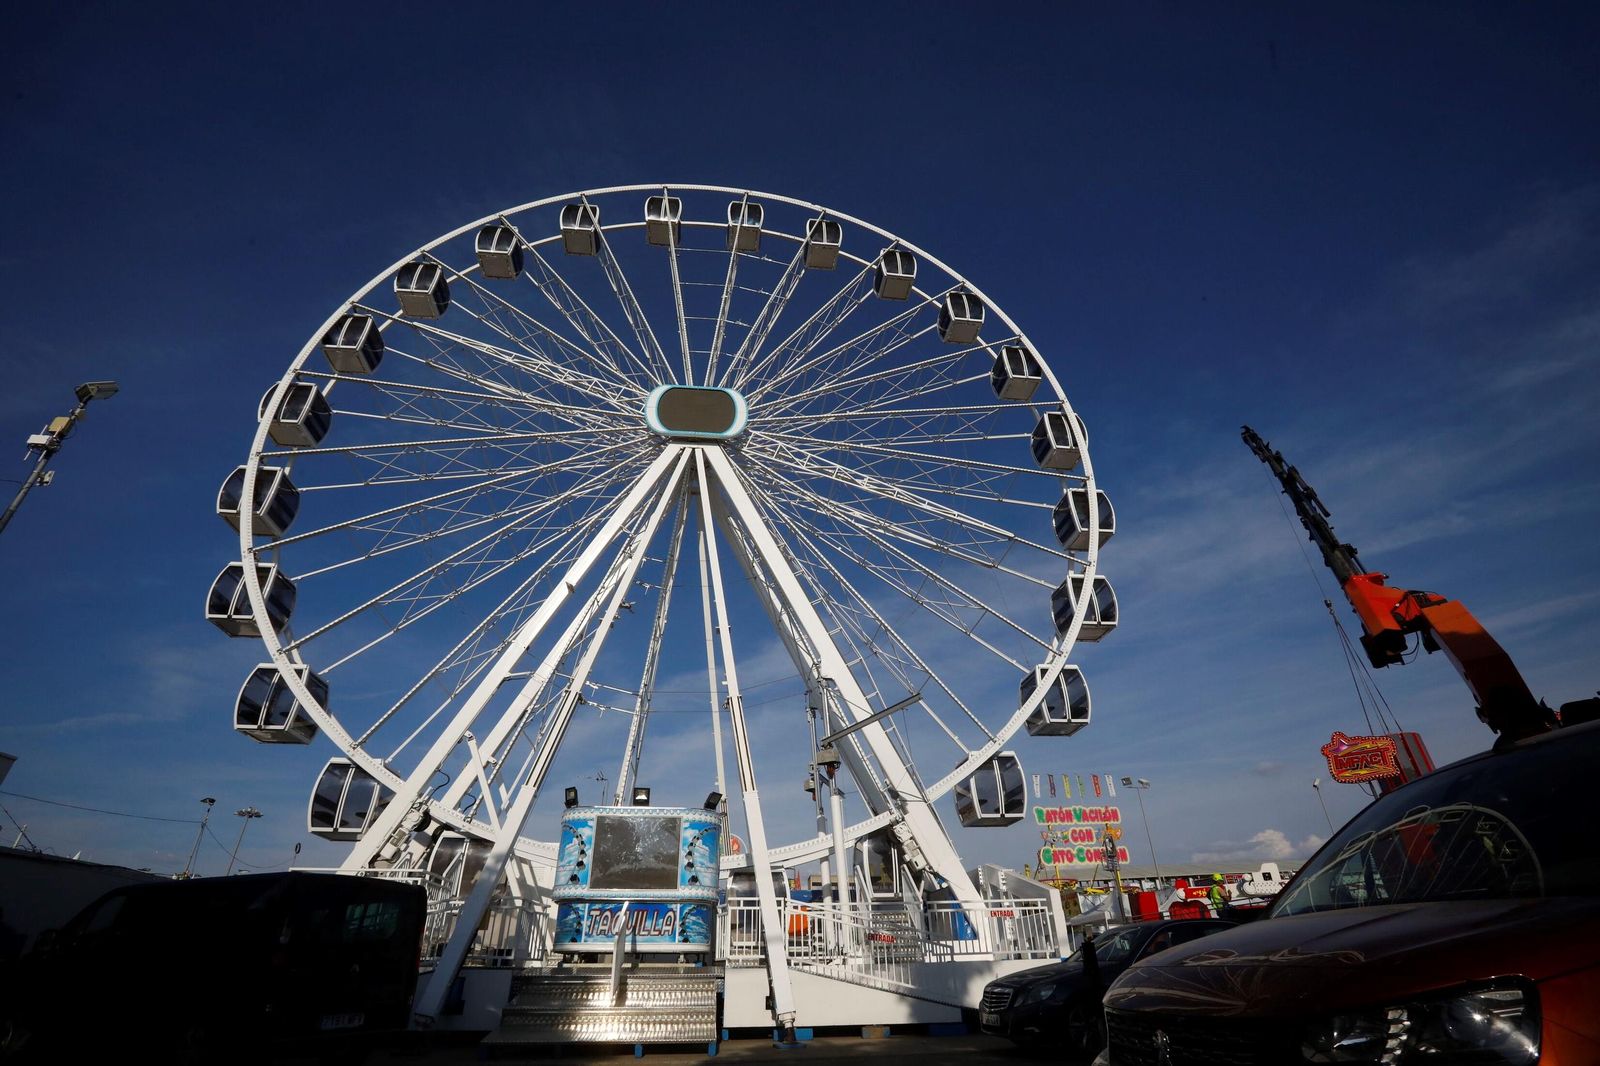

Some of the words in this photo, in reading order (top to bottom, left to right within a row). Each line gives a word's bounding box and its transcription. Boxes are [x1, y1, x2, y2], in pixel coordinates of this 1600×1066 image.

[1334, 746, 1391, 769] IMPACT
[1034, 806, 1073, 823] RATÓN
[1073, 806, 1120, 823] VACILÓN
[1071, 828, 1095, 843] CON
[1042, 847, 1074, 864] GATO
[1075, 847, 1129, 863] COMN
[990, 909, 1015, 918] ENTRADA
[867, 932, 897, 943] ENTRADA
